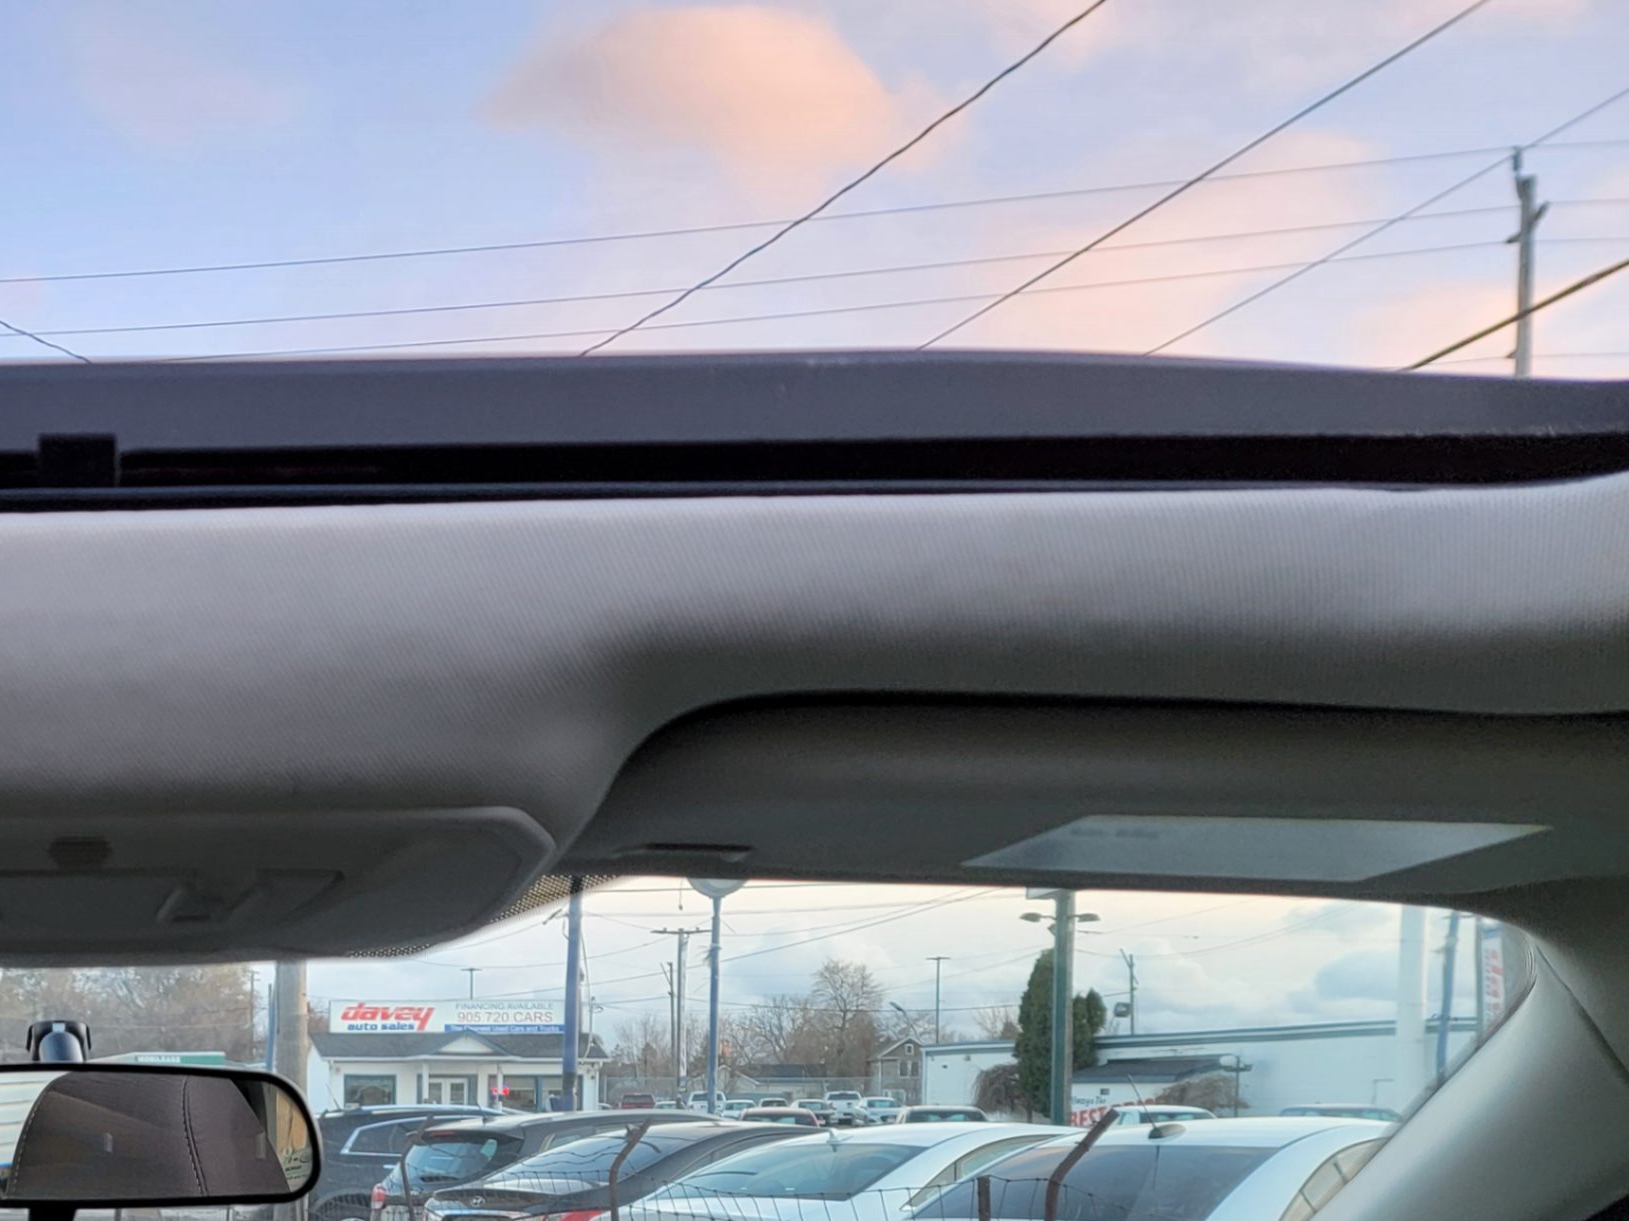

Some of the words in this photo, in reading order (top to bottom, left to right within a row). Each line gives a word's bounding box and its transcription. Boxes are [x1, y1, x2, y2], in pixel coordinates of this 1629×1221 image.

[507, 1002, 554, 1010] AVAILABLE
[340, 1000, 436, 1031] davey
[457, 1011, 481, 1023] 905
[484, 1011, 509, 1023] 720
[513, 1011, 554, 1023] CARS
[347, 1022, 378, 1031] auto
[380, 1021, 415, 1031] sales
